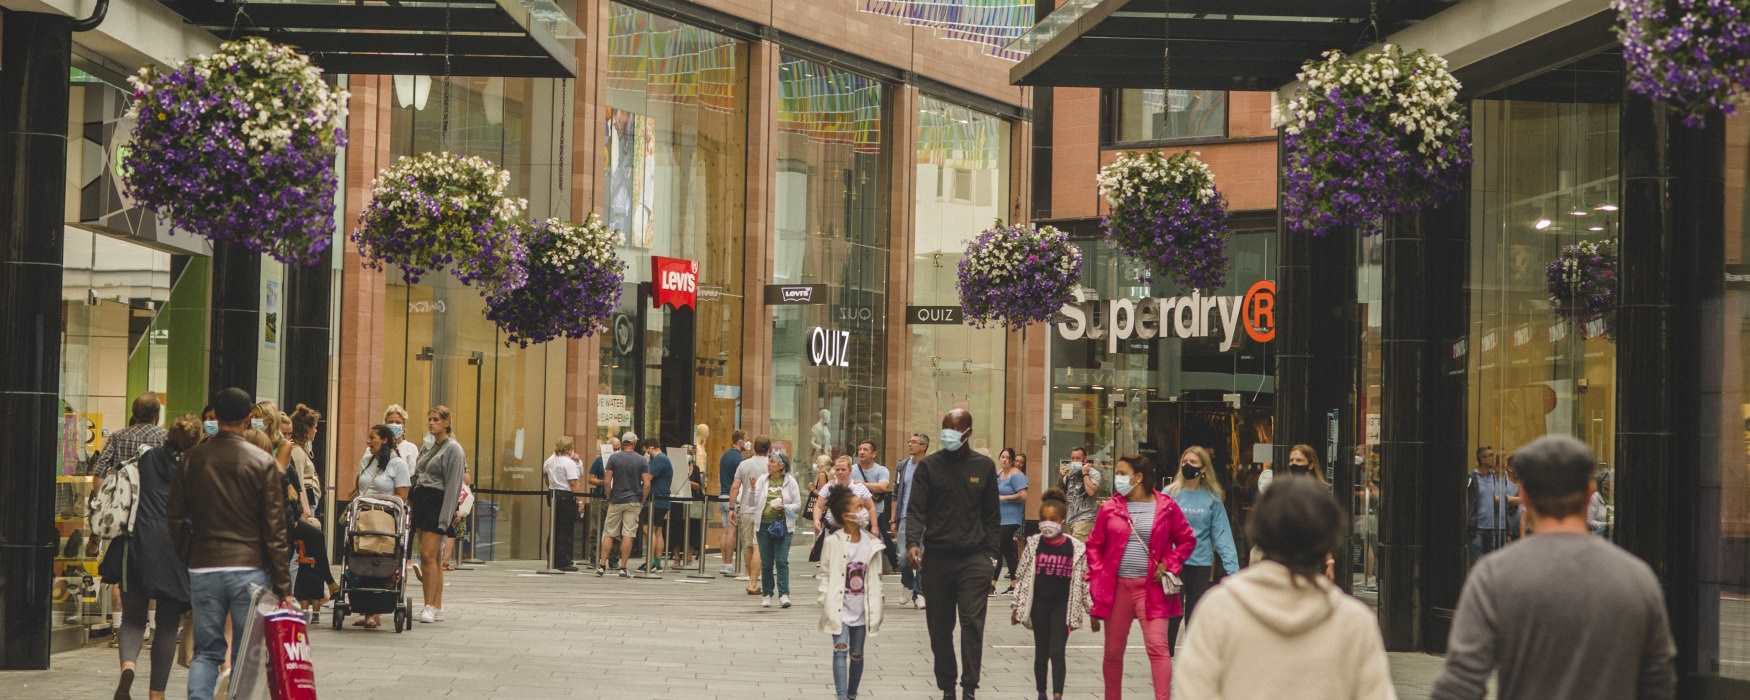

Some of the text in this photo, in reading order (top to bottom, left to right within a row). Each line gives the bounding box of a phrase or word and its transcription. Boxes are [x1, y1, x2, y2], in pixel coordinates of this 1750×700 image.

[917, 308, 953, 321] QUIZ
[1057, 284, 1245, 354] Superdry
[811, 326, 850, 367] QUIZ
